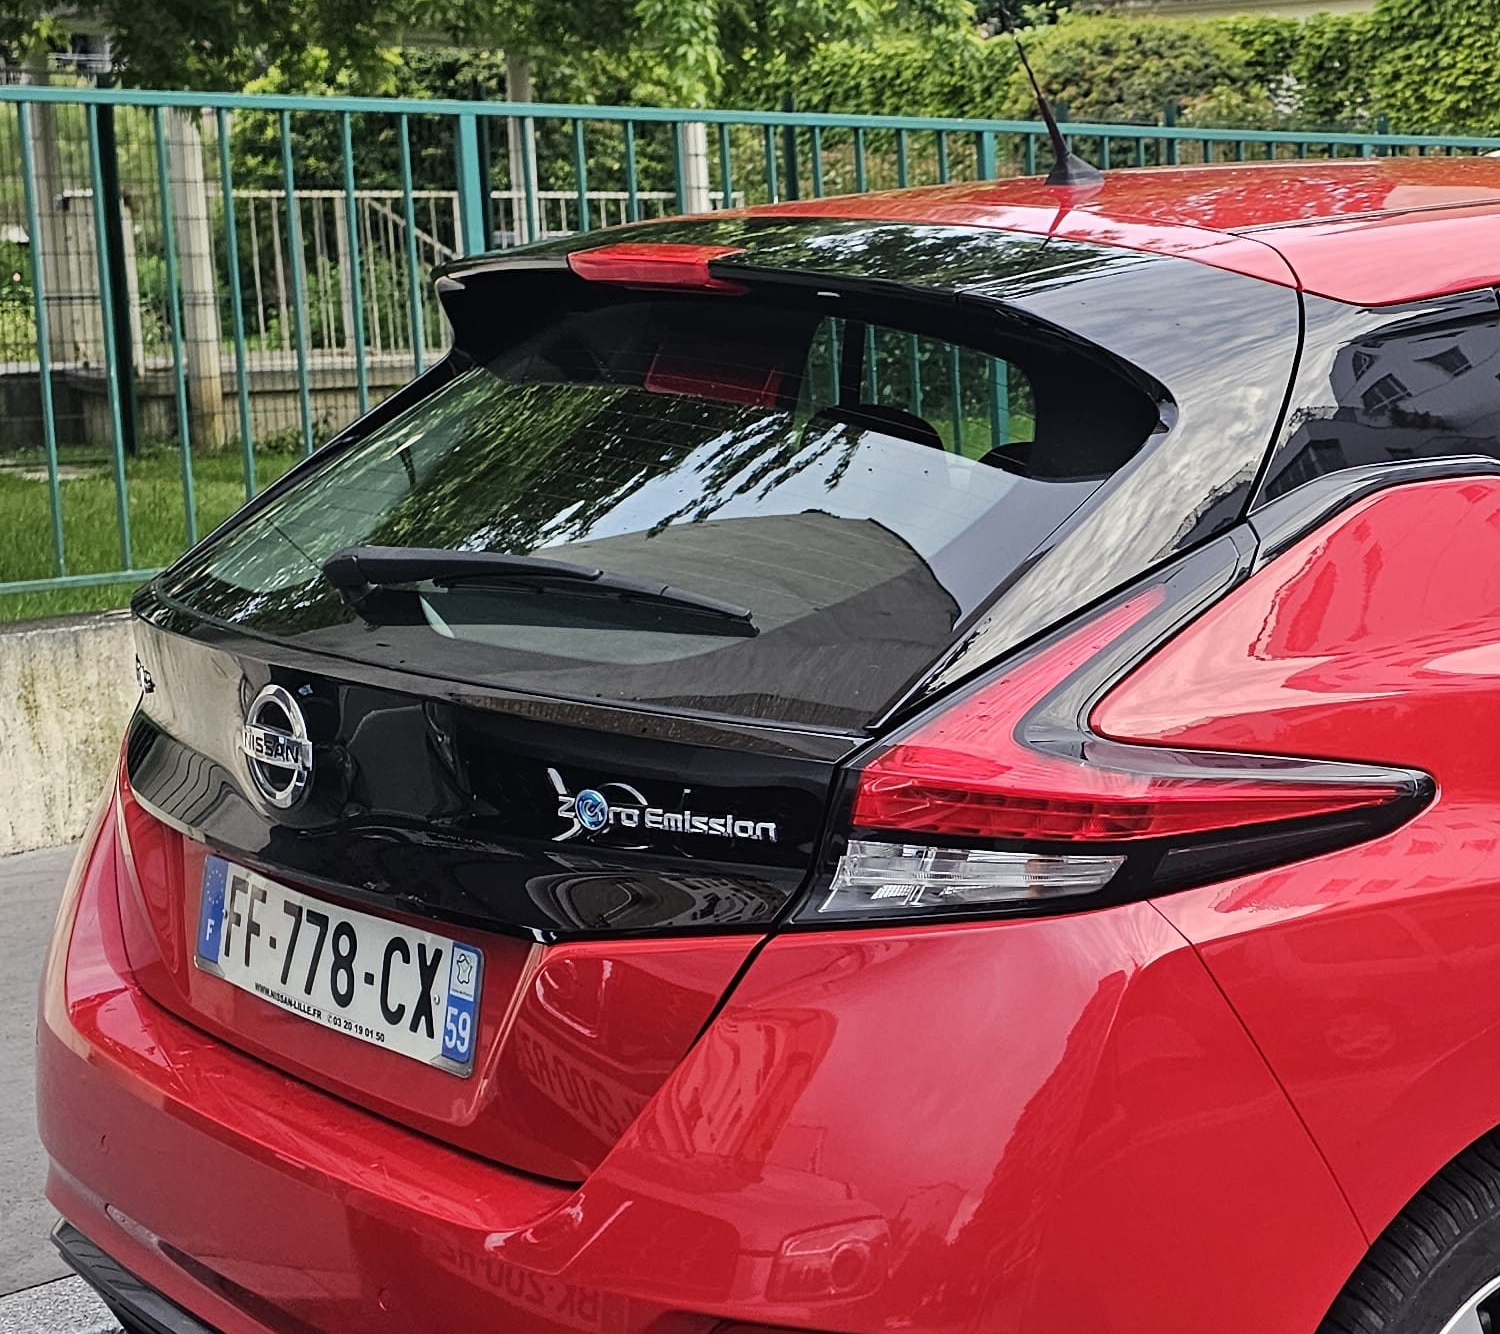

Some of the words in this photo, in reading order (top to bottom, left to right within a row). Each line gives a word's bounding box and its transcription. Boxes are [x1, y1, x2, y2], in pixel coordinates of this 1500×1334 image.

[243, 731, 299, 764] NISSAN
[644, 808, 778, 843] Emission
[205, 918, 215, 941] F
[224, 874, 443, 1040] FF-778-CX
[444, 1006, 472, 1054] 59
